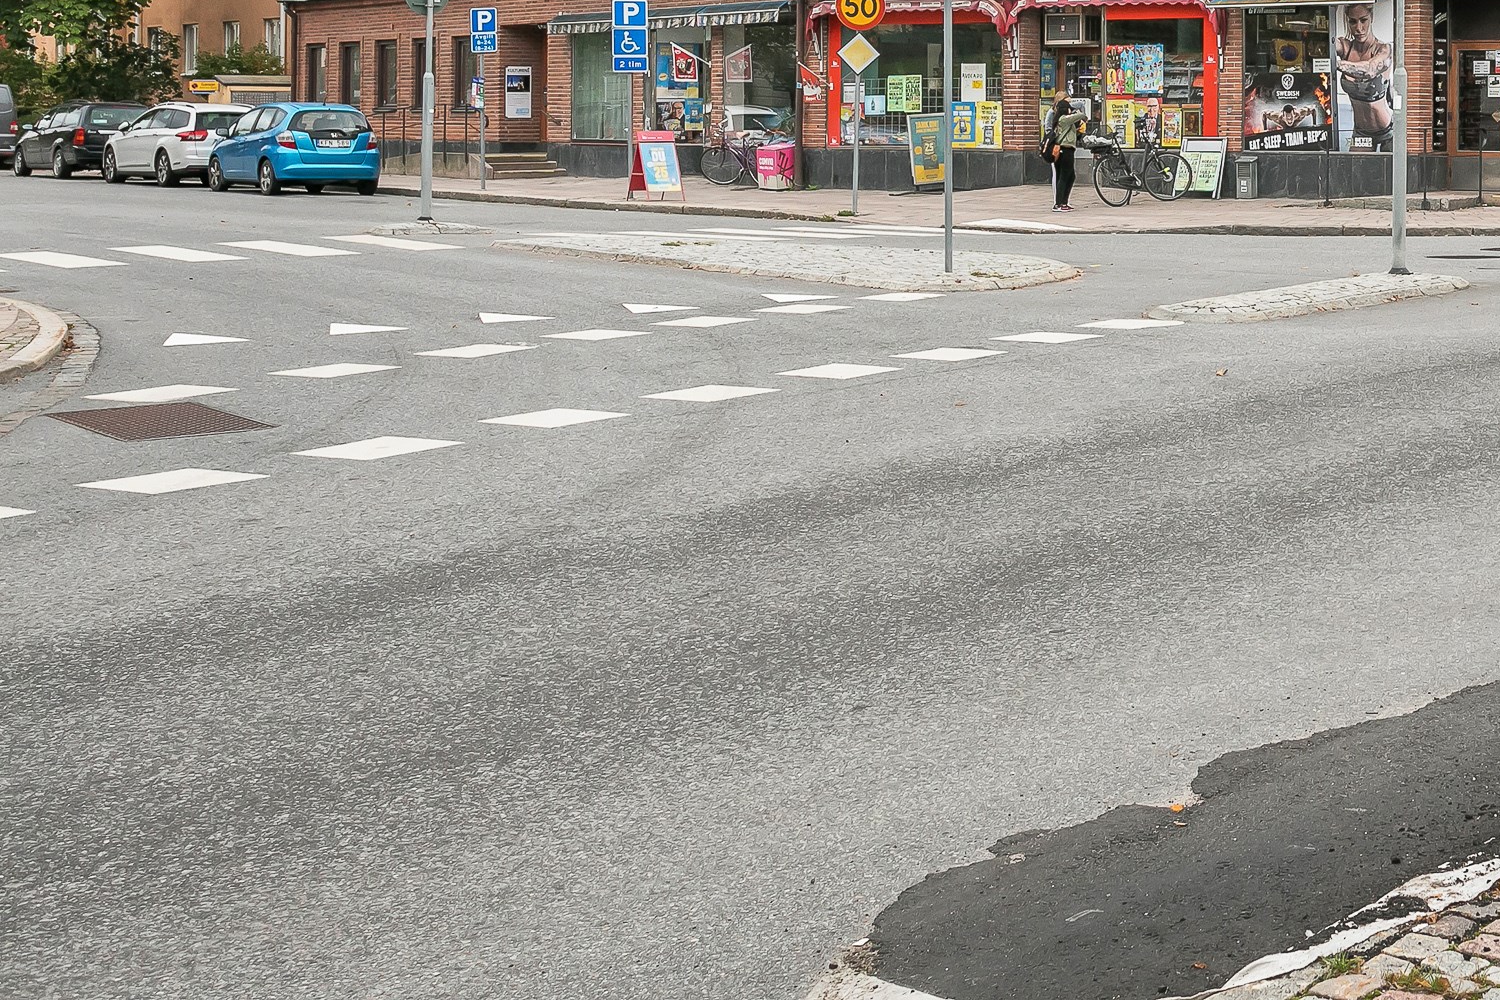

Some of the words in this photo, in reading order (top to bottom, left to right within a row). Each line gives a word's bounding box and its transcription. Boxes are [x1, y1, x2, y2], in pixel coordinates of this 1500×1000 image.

[478, 11, 492, 30] P
[623, 2, 639, 24] P
[1249, 139, 1261, 150] EAT
[1263, 134, 1281, 149] SLEEP
[1285, 131, 1304, 147] TRAIN
